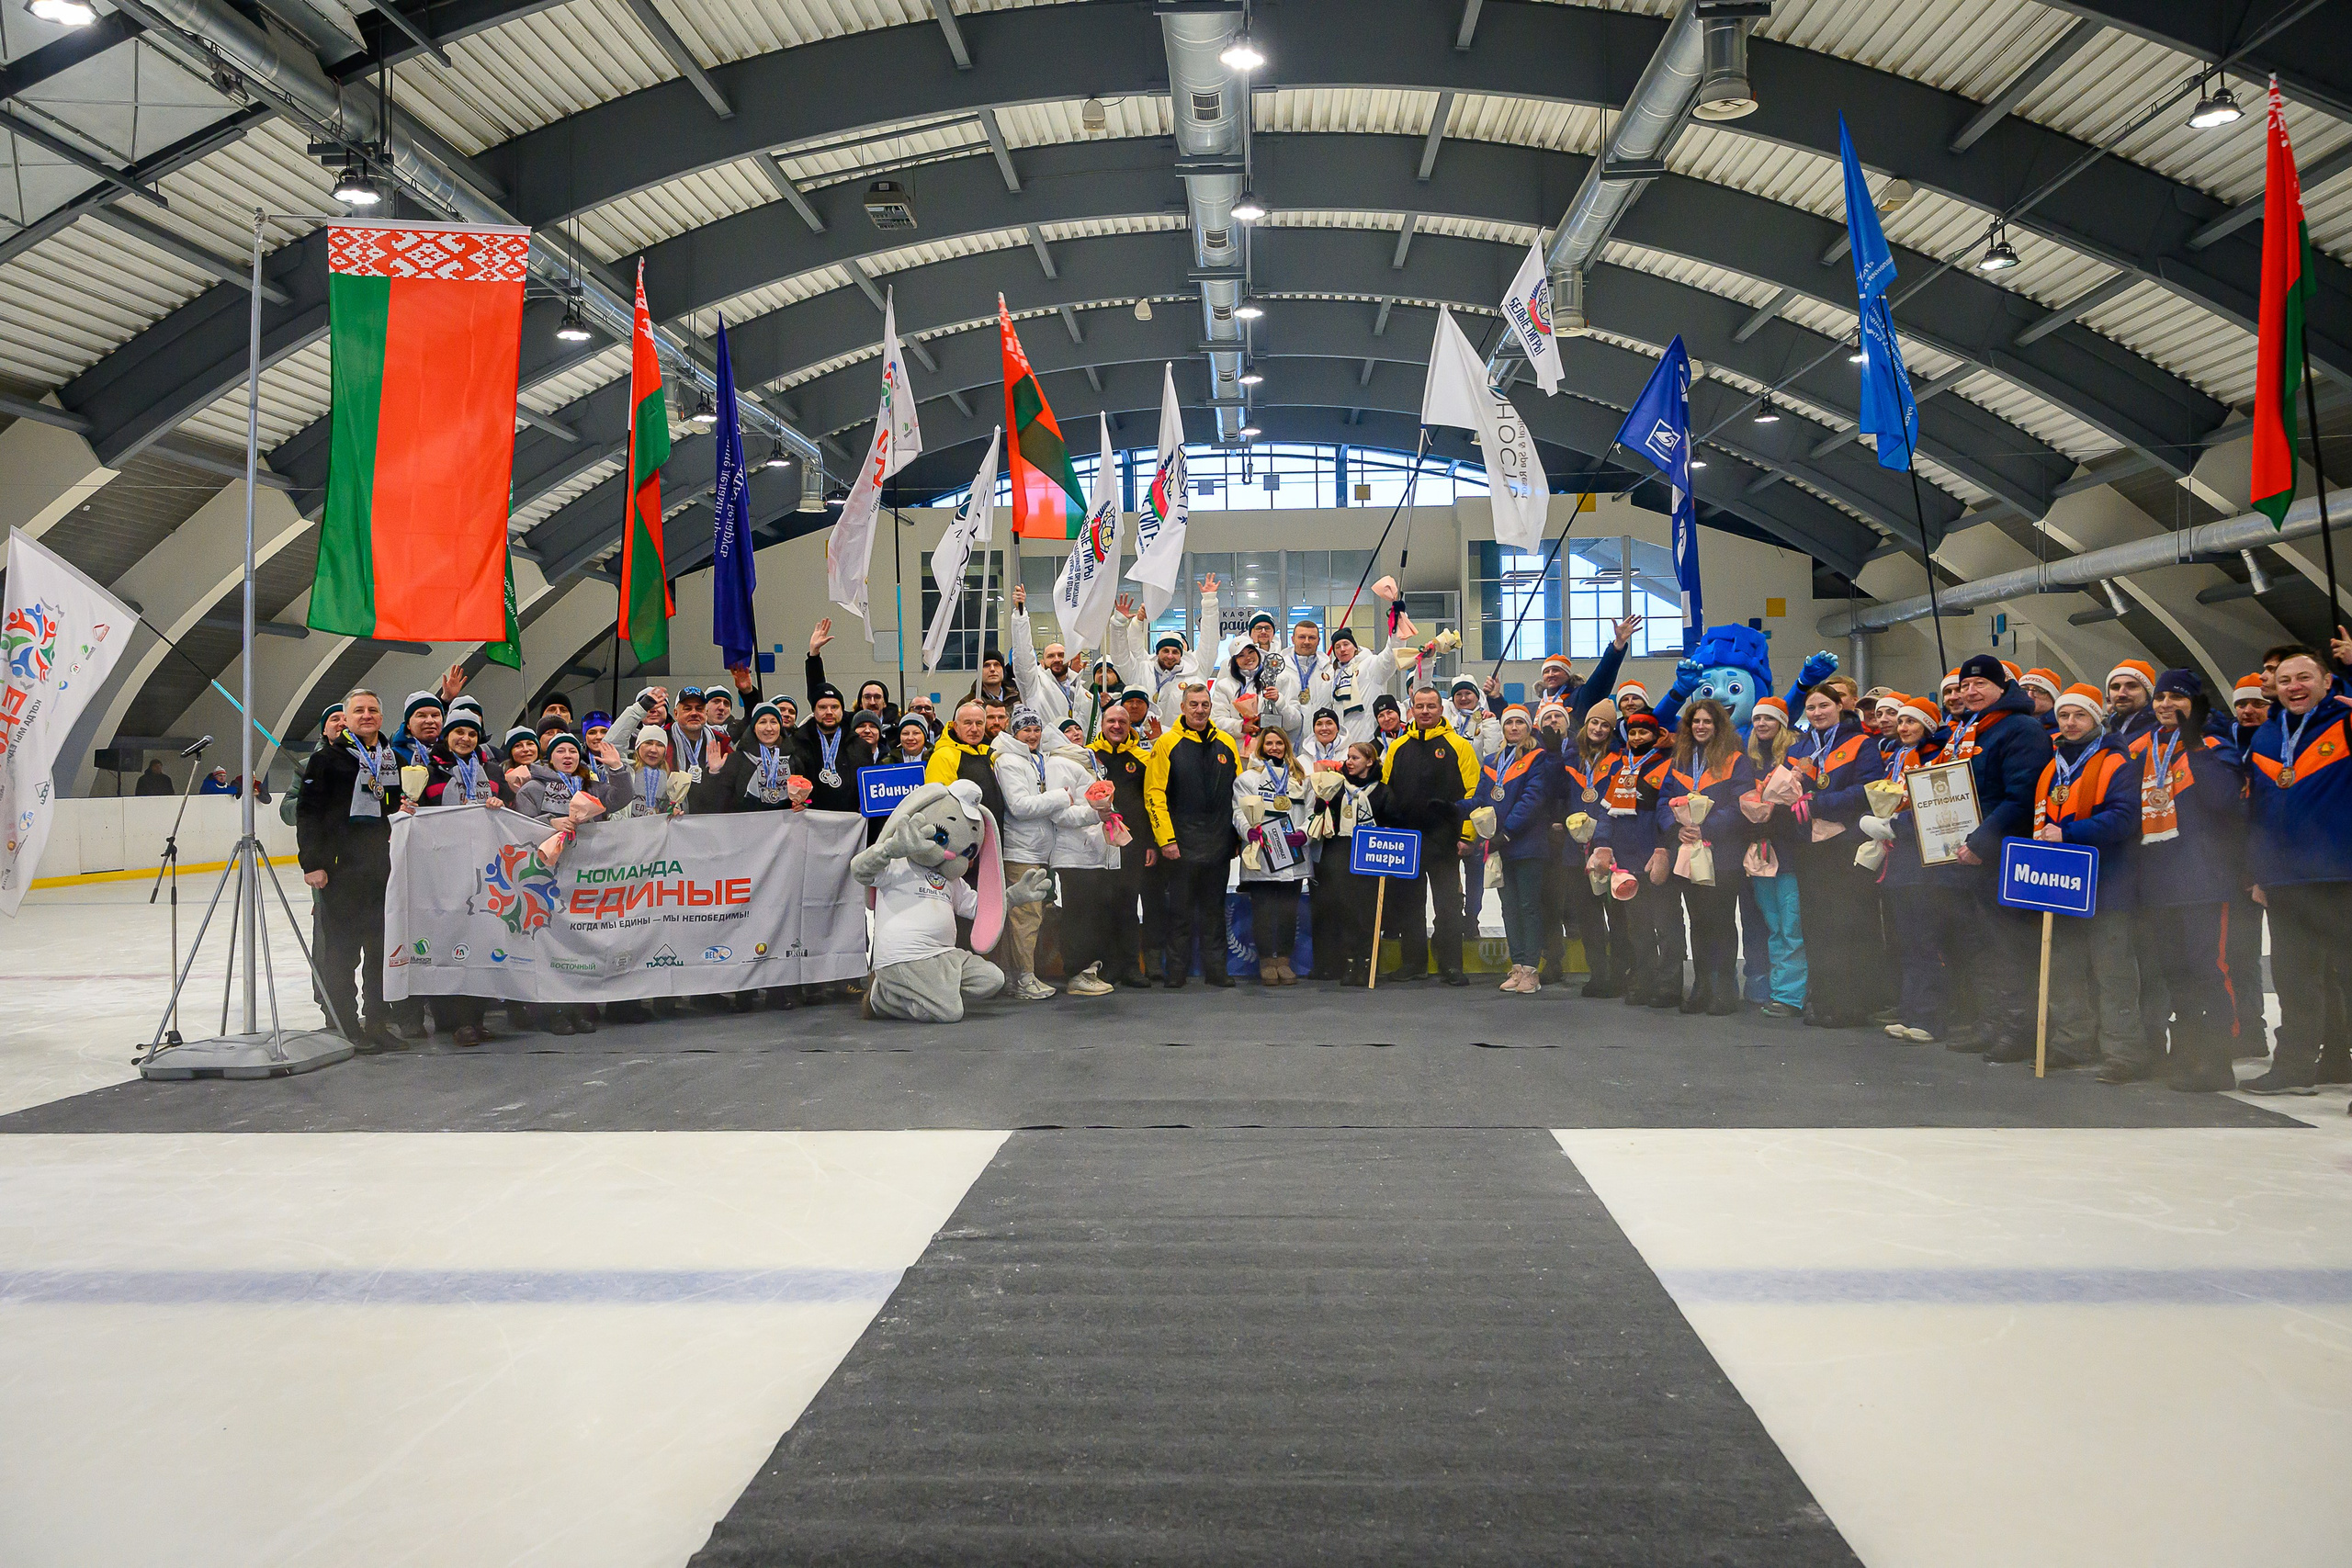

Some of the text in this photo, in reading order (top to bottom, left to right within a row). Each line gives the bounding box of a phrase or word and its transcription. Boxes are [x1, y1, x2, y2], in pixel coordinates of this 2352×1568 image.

[1509, 297, 1546, 356] БЕЛЫЕ ТИГРЫ
[1083, 547, 1094, 581] ТИГРЫ
[1917, 793, 1970, 808] СЕРТИФИКАТ
[1369, 837, 1405, 851] Белые
[1365, 853, 1406, 867] тигры
[576, 861, 684, 883] КОМАНДА
[2015, 863, 2082, 892] Молния
[570, 878, 751, 919] ЕДИНЫЕ
[570, 921, 598, 931] КОГДА
[601, 921, 616, 930] МЫ
[619, 918, 650, 929] ЕДИНЫ
[683, 910, 750, 923] НЕПОБЕДИМЫ!
[550, 962, 596, 970] ВОСТОЧНЫЙ
